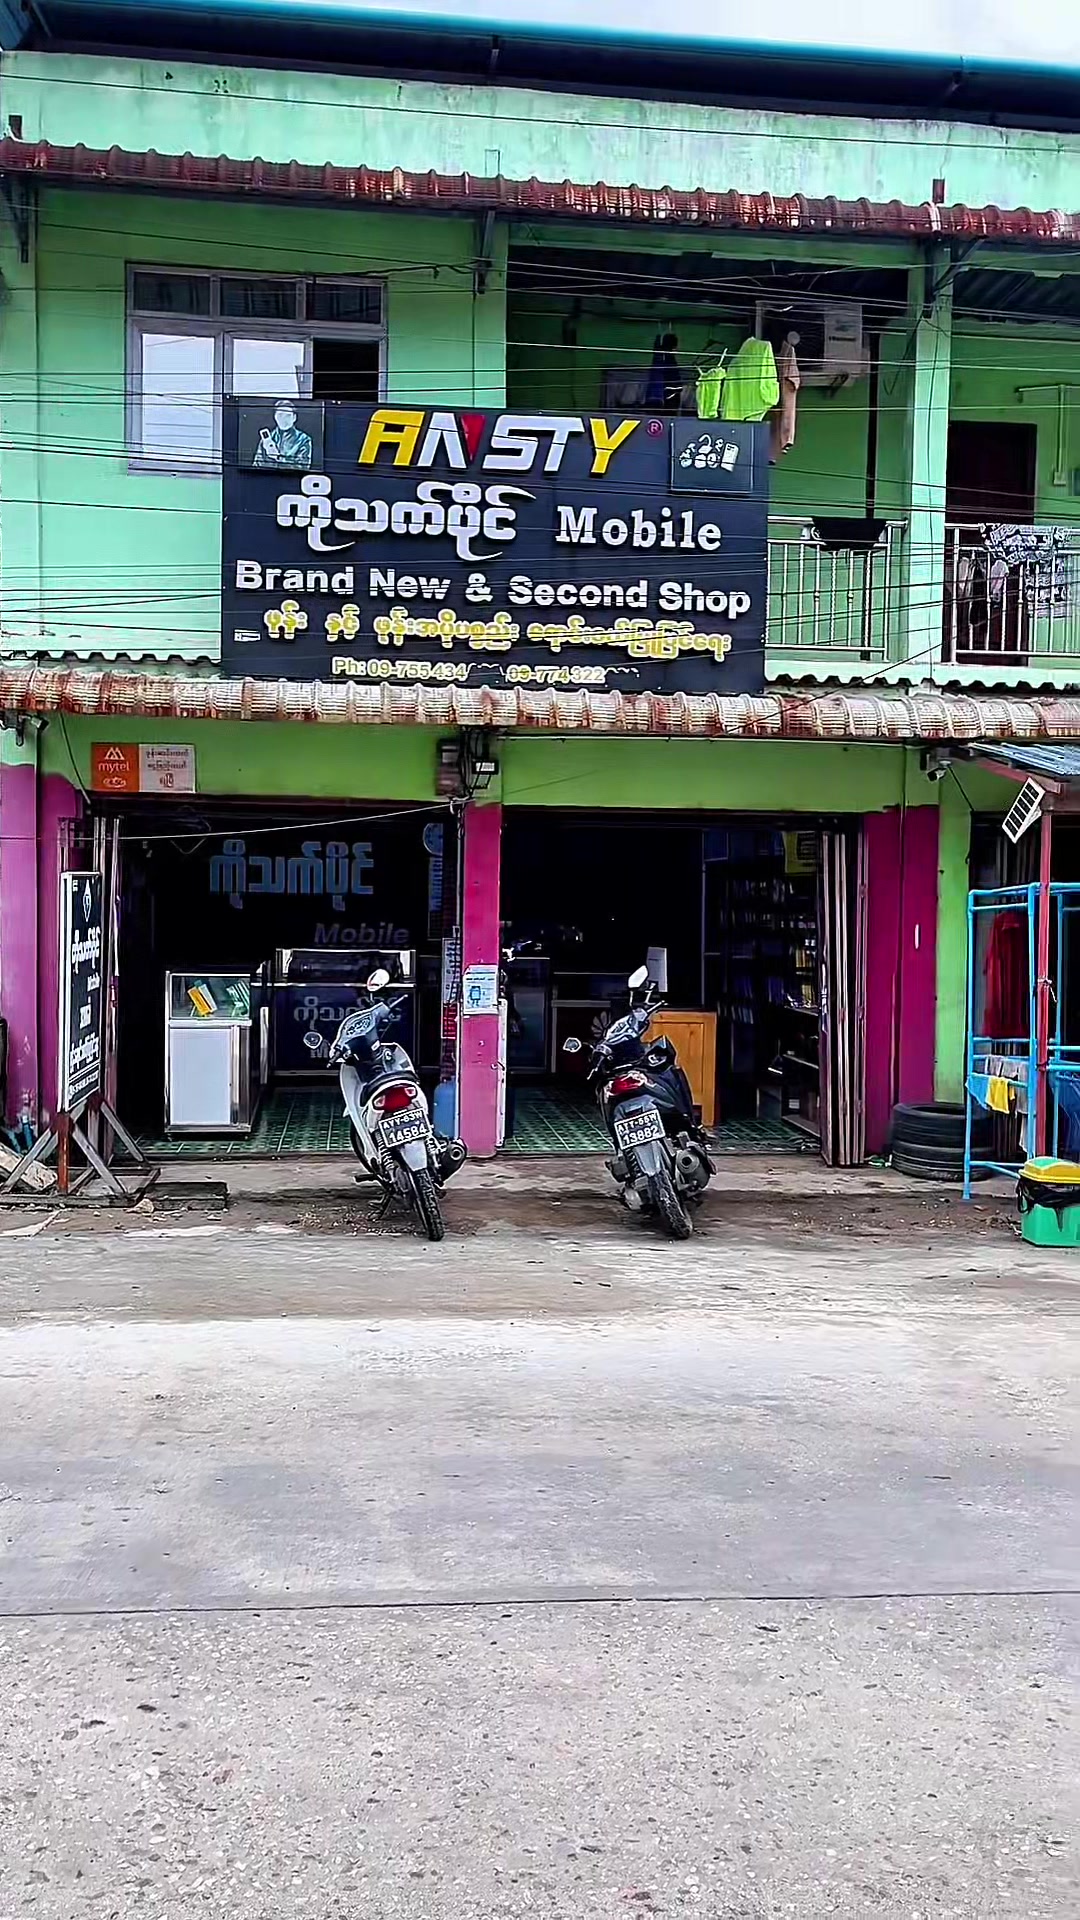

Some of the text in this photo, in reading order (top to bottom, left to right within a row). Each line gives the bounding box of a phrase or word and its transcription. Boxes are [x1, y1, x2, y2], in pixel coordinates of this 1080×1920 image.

[277, 474, 722, 561] ကိုသက်ပိုင် Mobile
[235, 559, 751, 619] Brand New & Second Shop
[98, 761, 131, 773] mytel
[314, 922, 409, 944] Mobile
[389, 1122, 427, 1143] 14584
[623, 1124, 658, 1145] 13882
